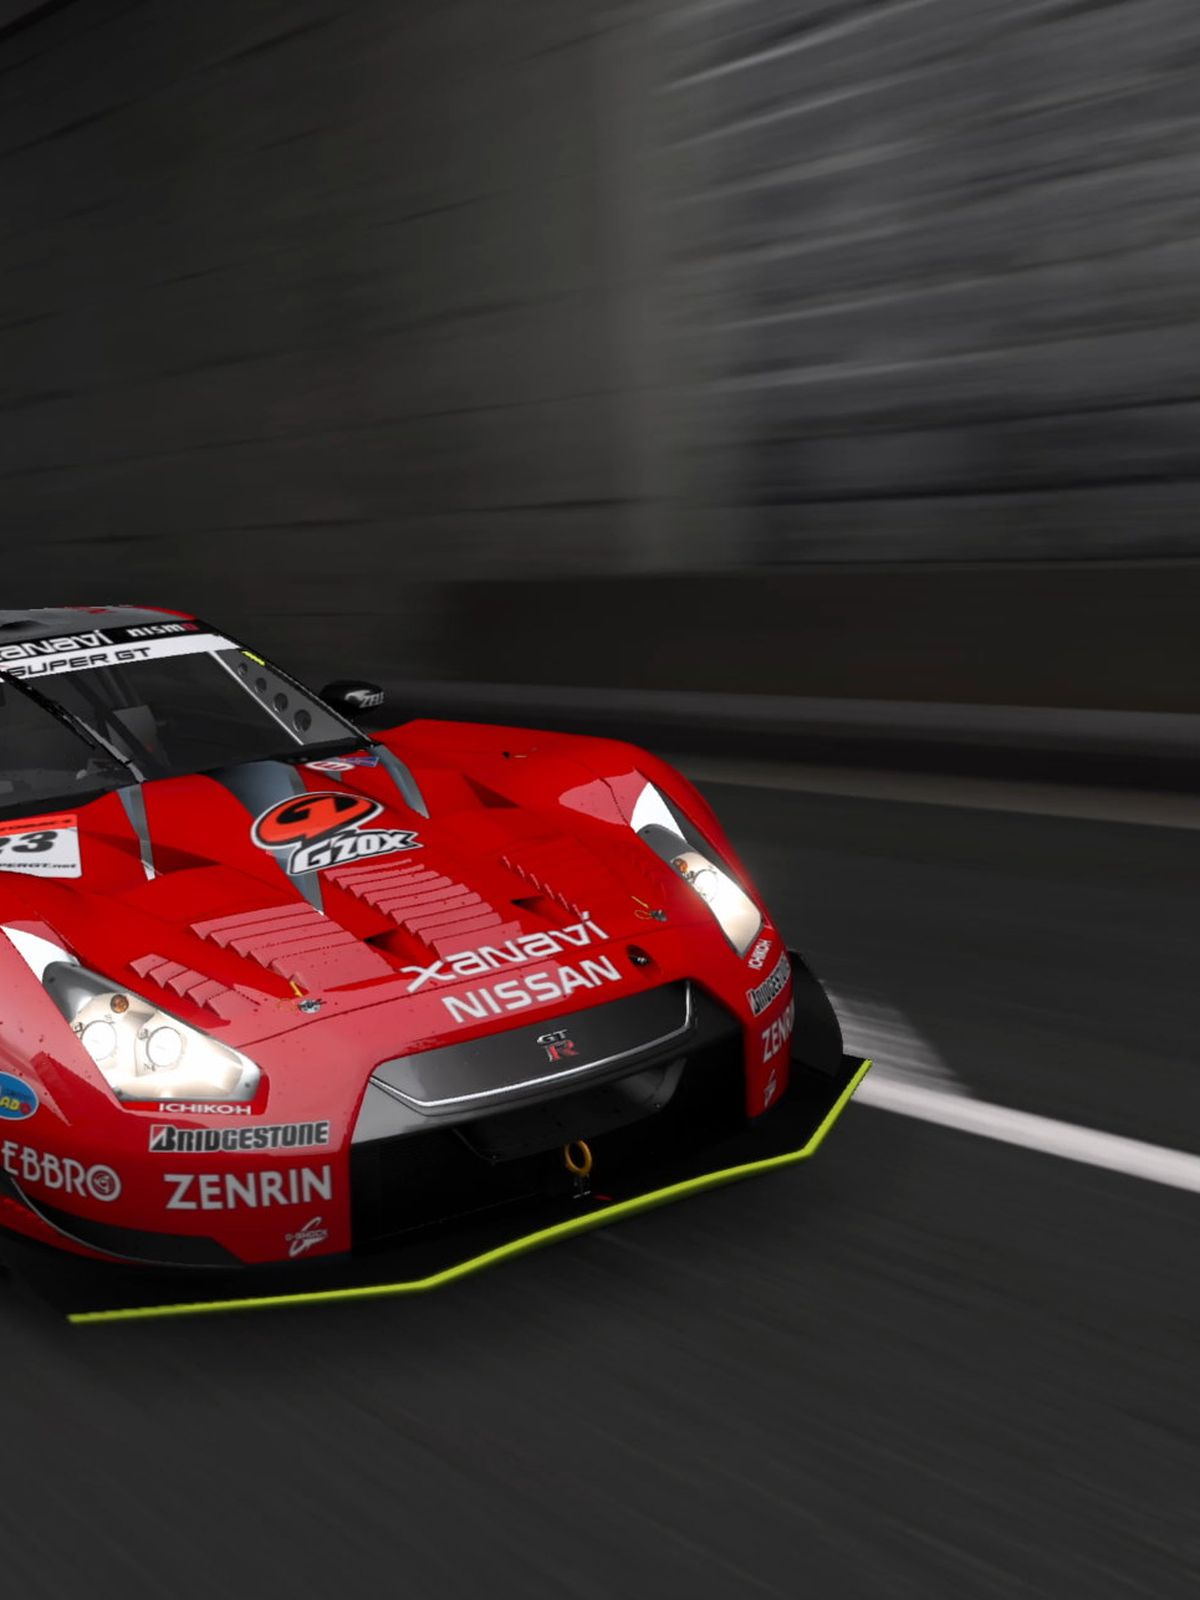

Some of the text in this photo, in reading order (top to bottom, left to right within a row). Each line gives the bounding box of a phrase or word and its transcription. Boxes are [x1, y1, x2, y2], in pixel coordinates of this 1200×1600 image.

[6, 647, 150, 678] SUPER GT
[441, 955, 624, 1024] NISSAN
[536, 1028, 569, 1045] GT
[544, 1039, 579, 1063] R
[159, 1103, 252, 1116] ICHIKOH
[149, 1121, 329, 1152] BRIDGESTONE
[1, 1140, 122, 1201] EBBRO
[163, 1165, 333, 1211] ZENRIN
